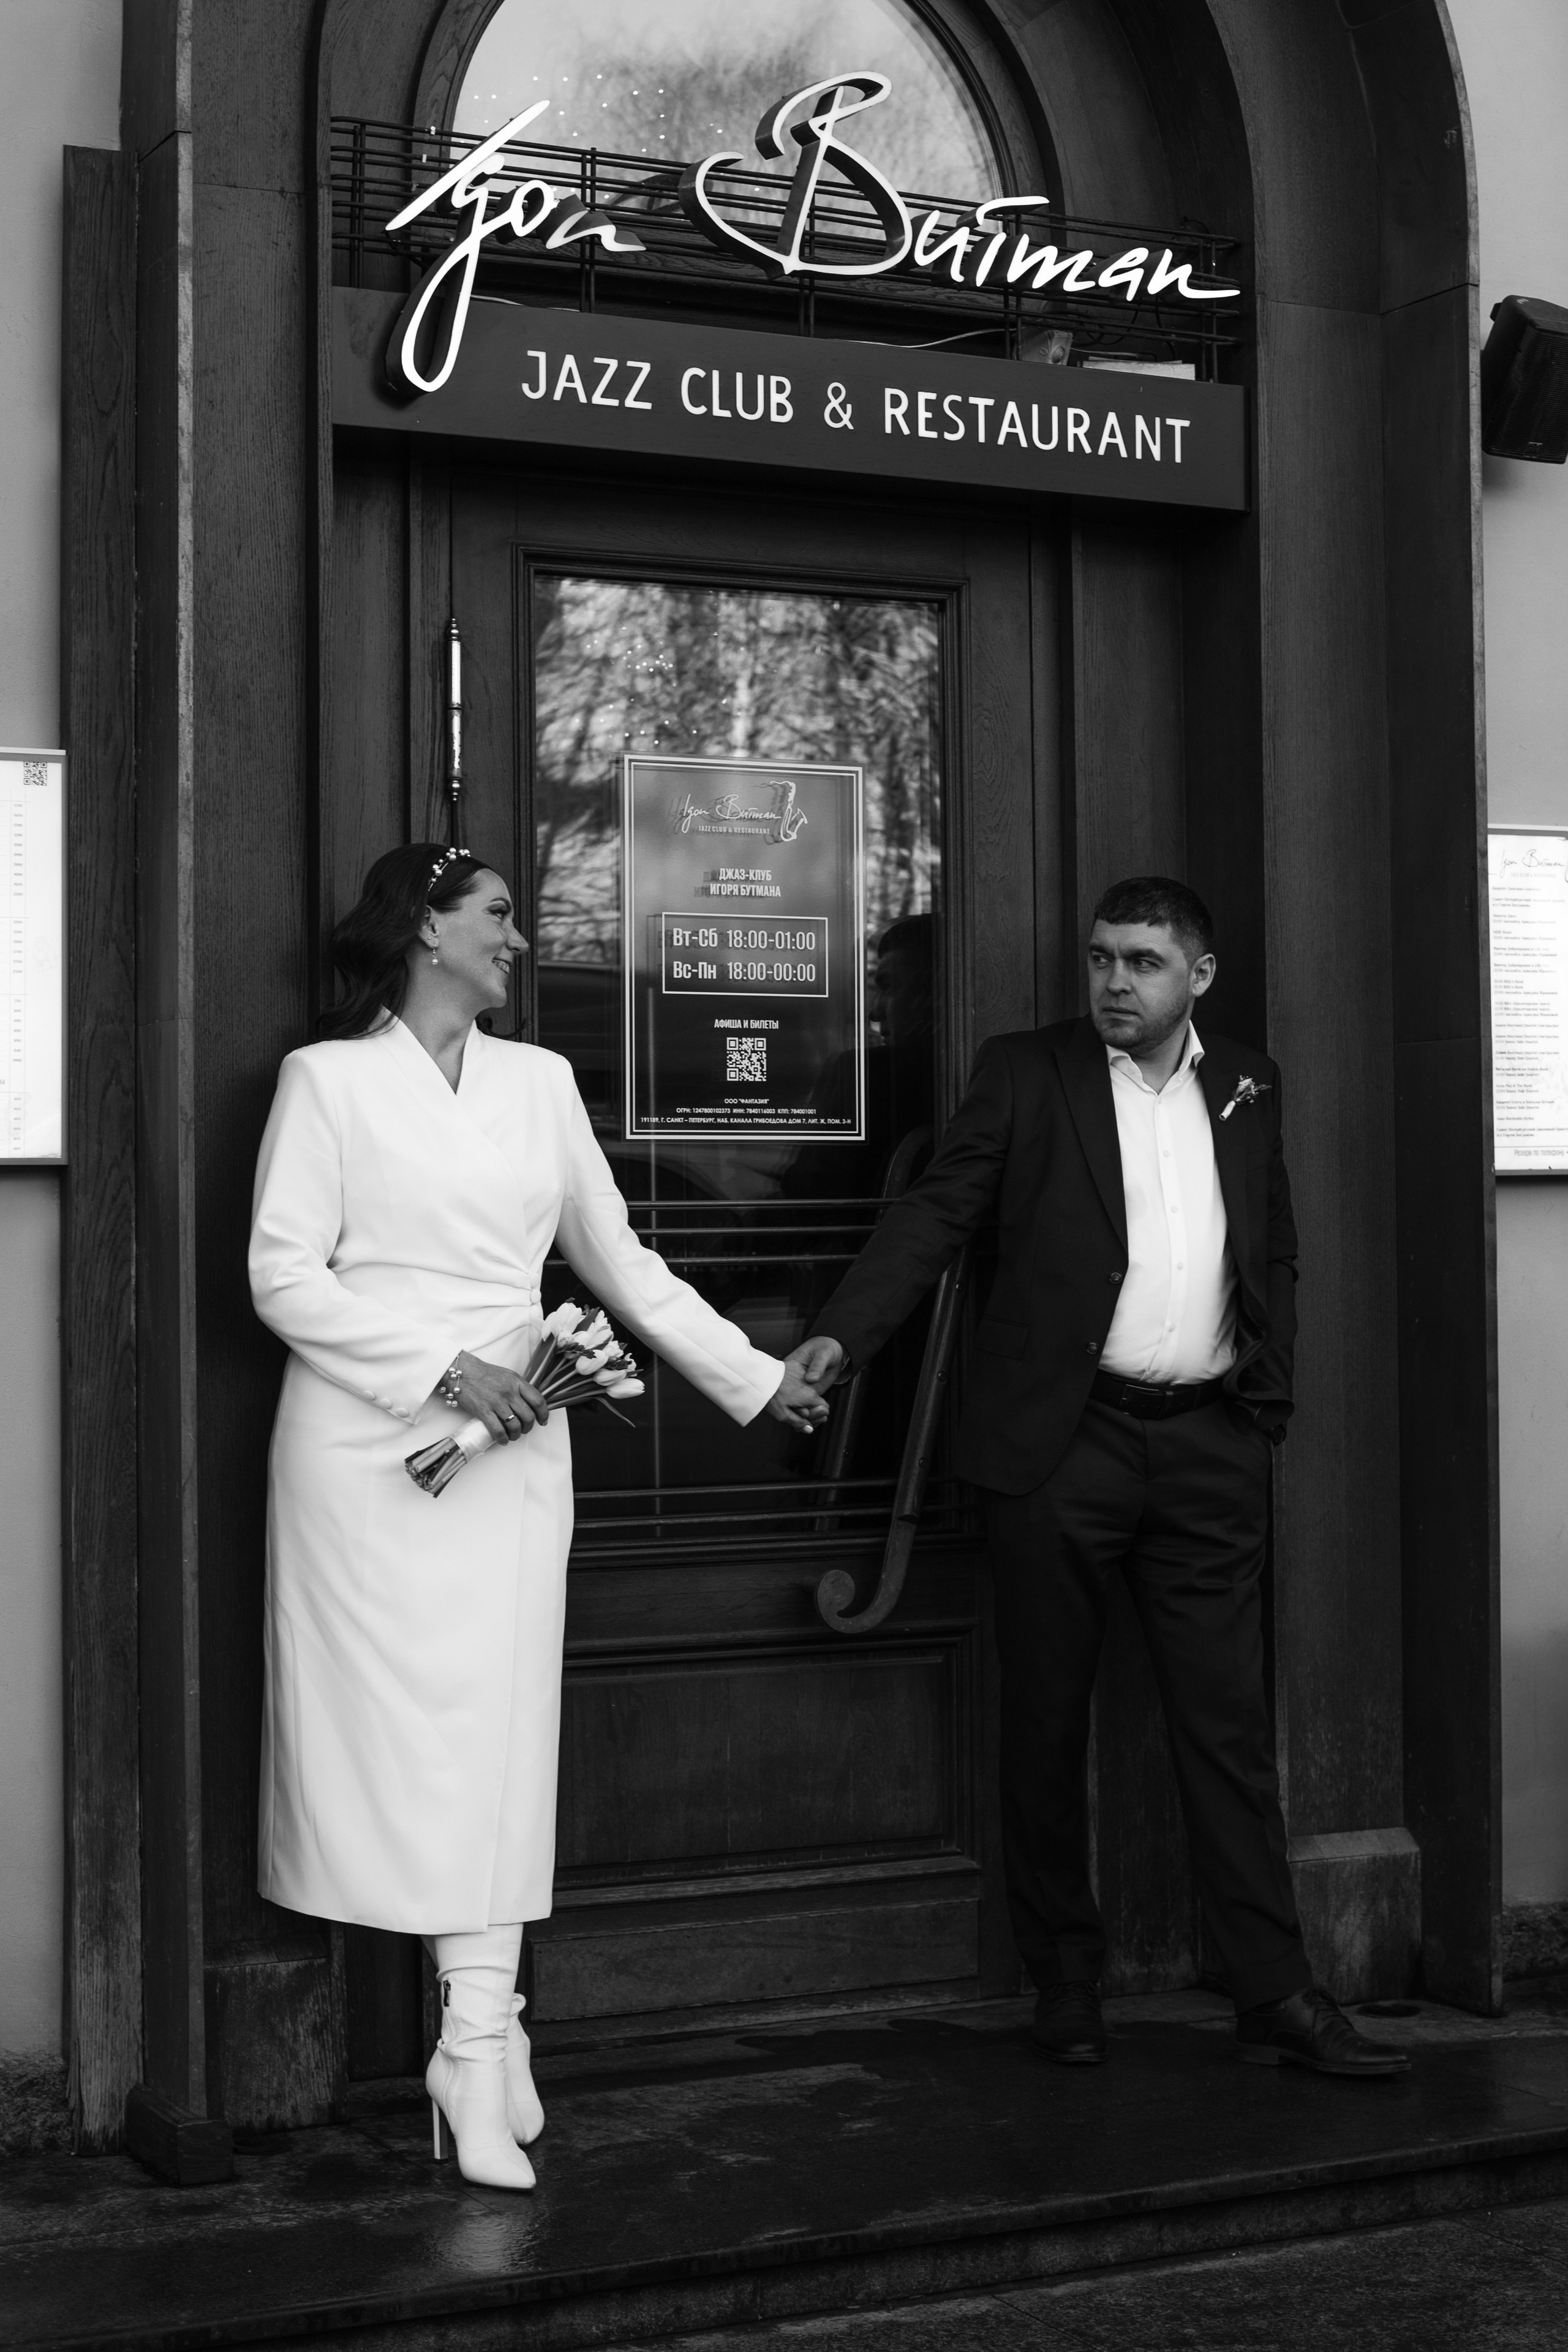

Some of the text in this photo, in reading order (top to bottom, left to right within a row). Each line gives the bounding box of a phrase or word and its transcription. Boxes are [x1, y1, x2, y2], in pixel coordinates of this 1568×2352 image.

[695, 70, 1241, 301] Butman
[521, 350, 1191, 464] JAZZ CLUB & RESTAURANT
[715, 794, 782, 820] Butman
[718, 868, 772, 881] ДЖАЗ-КЛУБ
[709, 883, 782, 897] ИГОРЯ БУТМАНА
[673, 927, 816, 950] Вт-Сб 18:00-01:00
[673, 960, 816, 982] Вс-Пн 18:00-00:00
[714, 1019, 779, 1030] АФИША И БИЛЕТЫ
